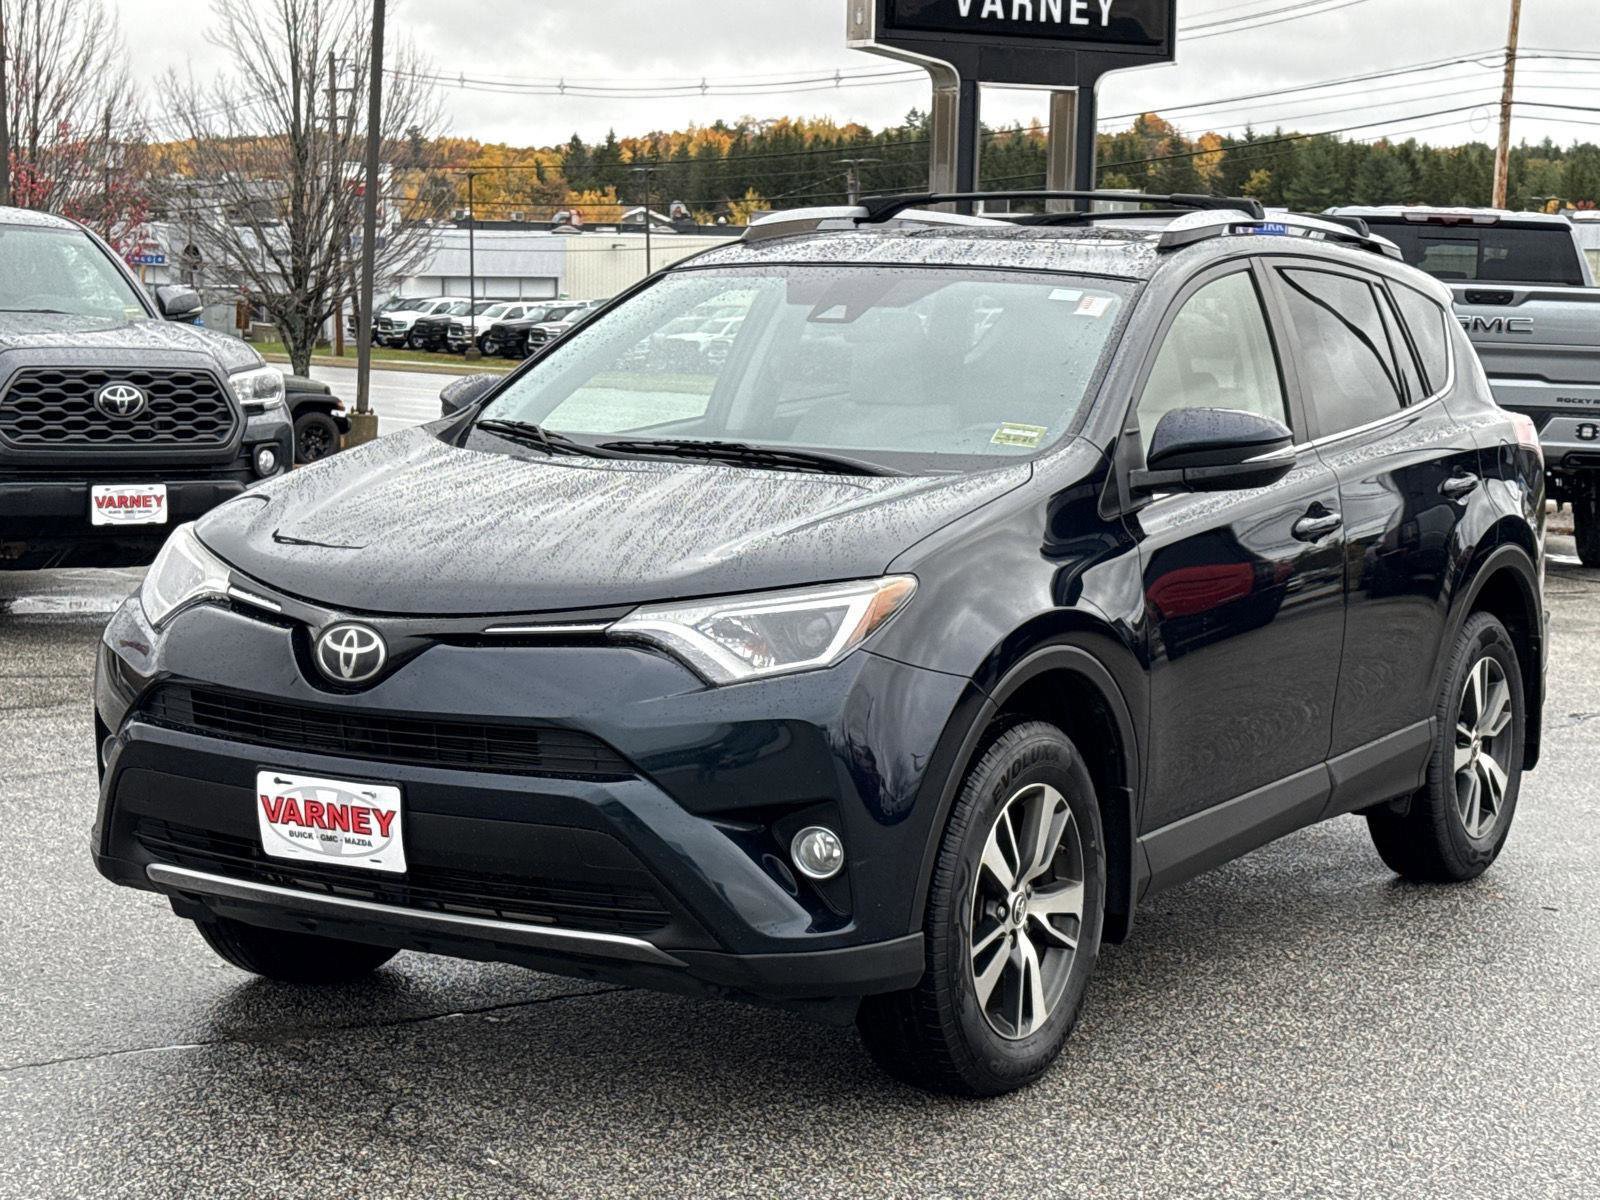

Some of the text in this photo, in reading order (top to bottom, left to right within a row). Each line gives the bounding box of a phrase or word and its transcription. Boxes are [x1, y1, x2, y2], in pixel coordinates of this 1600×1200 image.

[94, 494, 165, 509] VARNEY
[260, 794, 397, 838] VARNEY
[289, 830, 373, 848] BUICK GMC MAZDA
